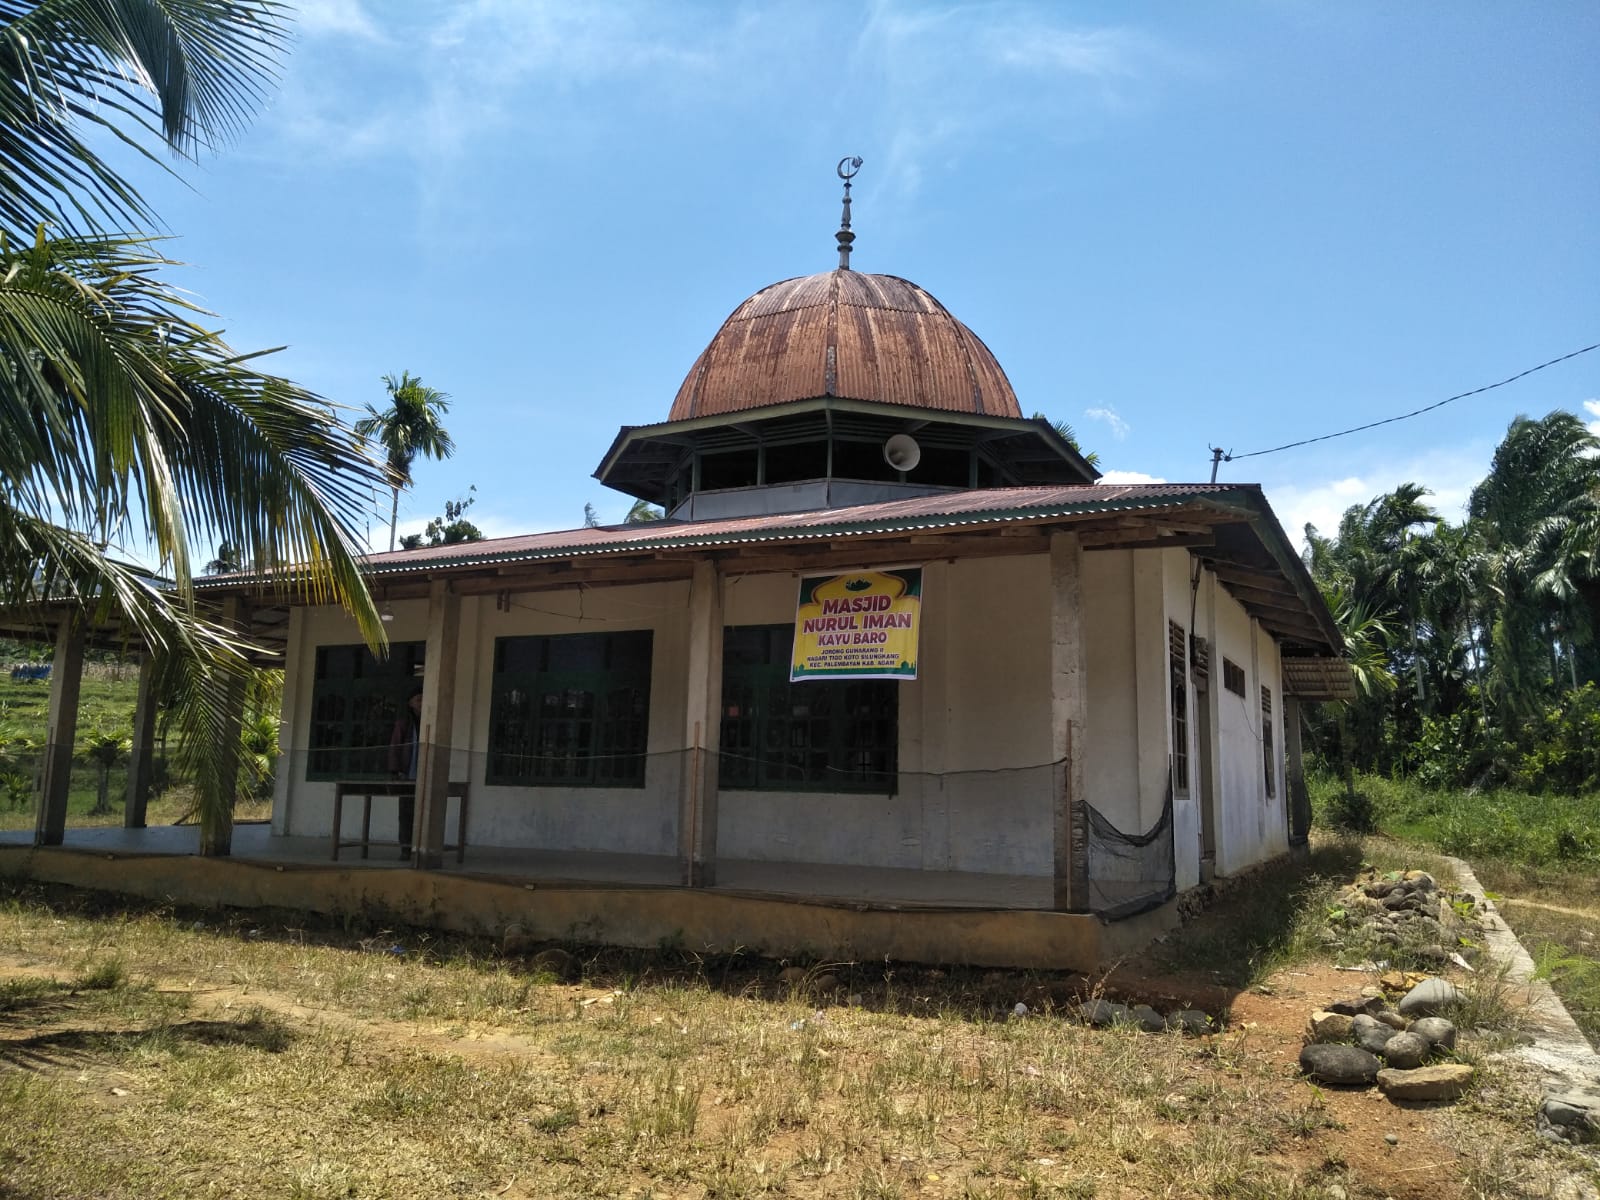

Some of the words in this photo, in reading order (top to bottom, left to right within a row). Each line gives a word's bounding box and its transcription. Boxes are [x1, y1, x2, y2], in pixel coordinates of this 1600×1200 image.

[822, 595, 892, 614] MASJID
[803, 616, 858, 633] NURUL
[863, 613, 912, 629] IMAN
[818, 632, 851, 646] KAYU
[853, 631, 887, 645] BARO
